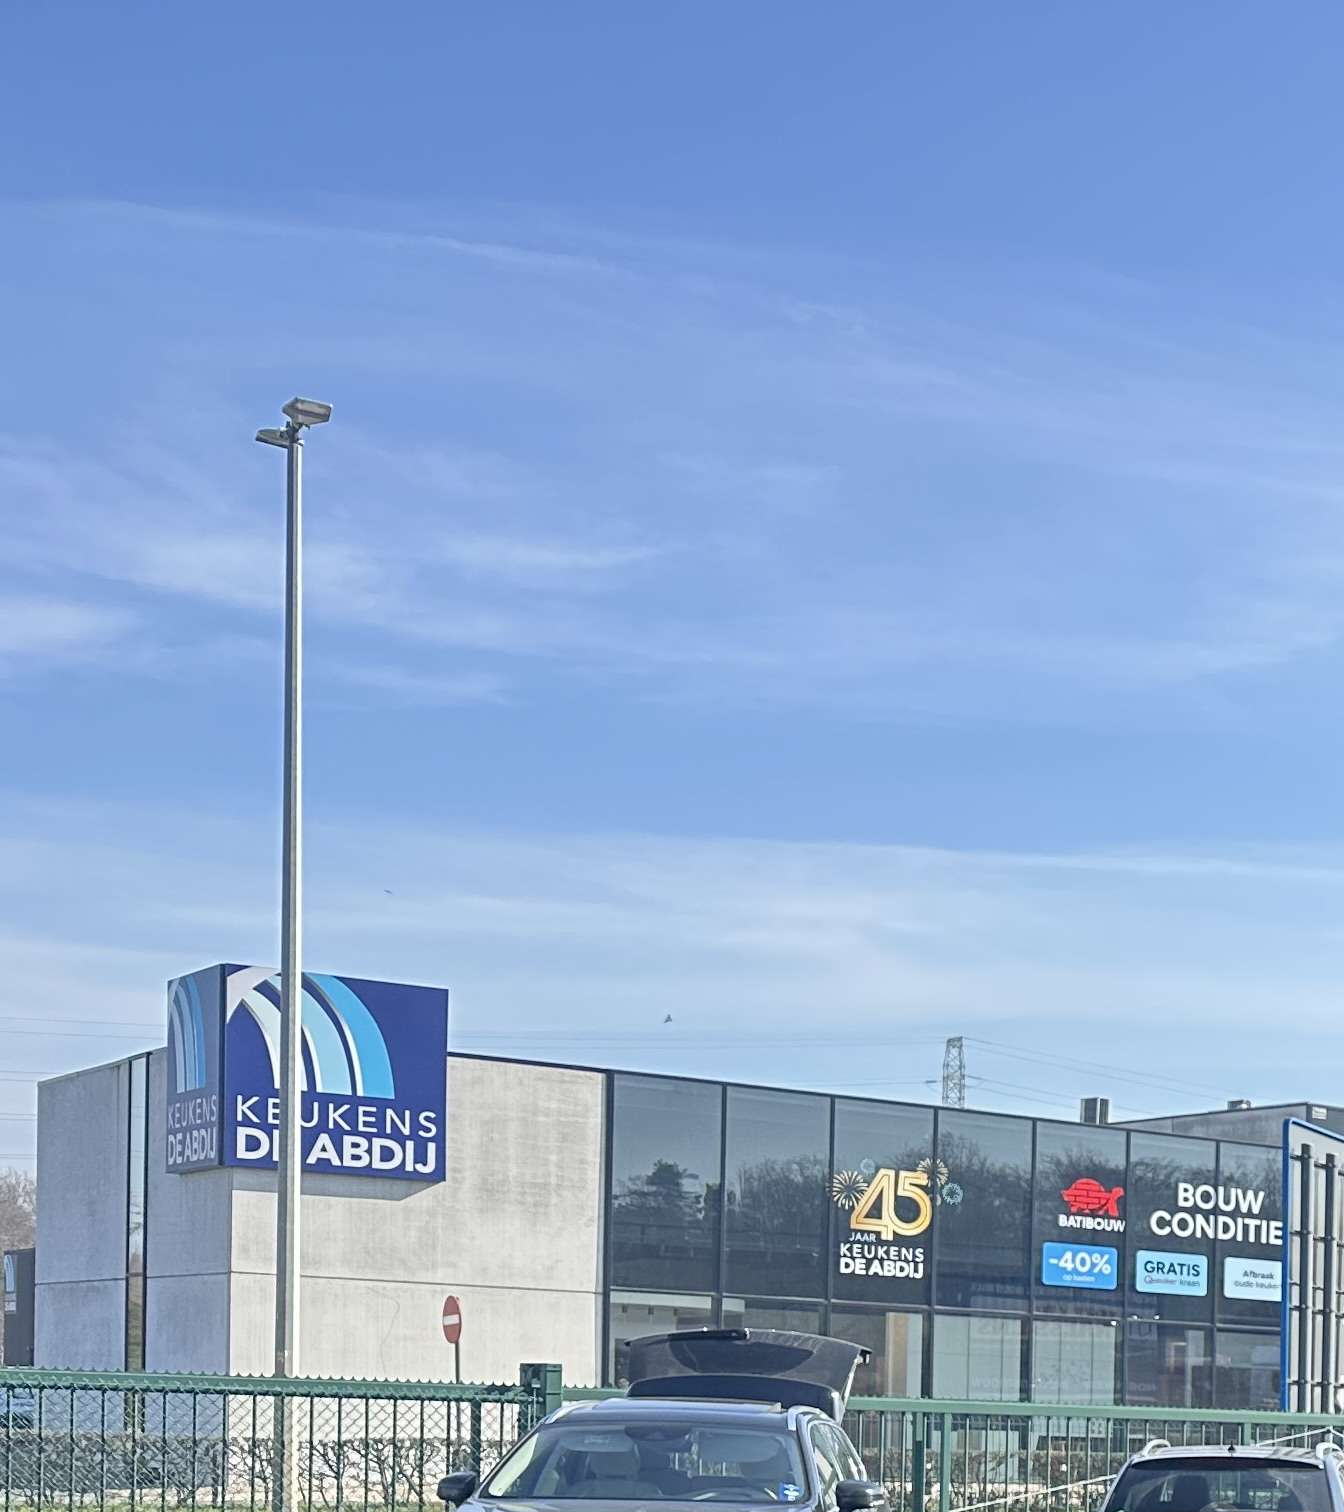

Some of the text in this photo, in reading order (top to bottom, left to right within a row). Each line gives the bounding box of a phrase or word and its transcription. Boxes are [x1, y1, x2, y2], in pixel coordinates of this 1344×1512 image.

[167, 1096, 217, 1129] KEUKENS
[167, 1126, 217, 1166] DE ABDIJ
[306, 1133, 437, 1174] ABDIJ
[850, 1168, 933, 1241] 45
[1177, 1182, 1265, 1215] BOUW
[1057, 1214, 1126, 1233] BATIBOUW
[849, 1232, 876, 1242] JAAR
[840, 1243, 924, 1262] KEUKENS
[1048, 1250, 1112, 1275] -40%
[840, 1257, 924, 1279] DE ABDIJ
[1143, 1260, 1201, 1278] GRATIS
